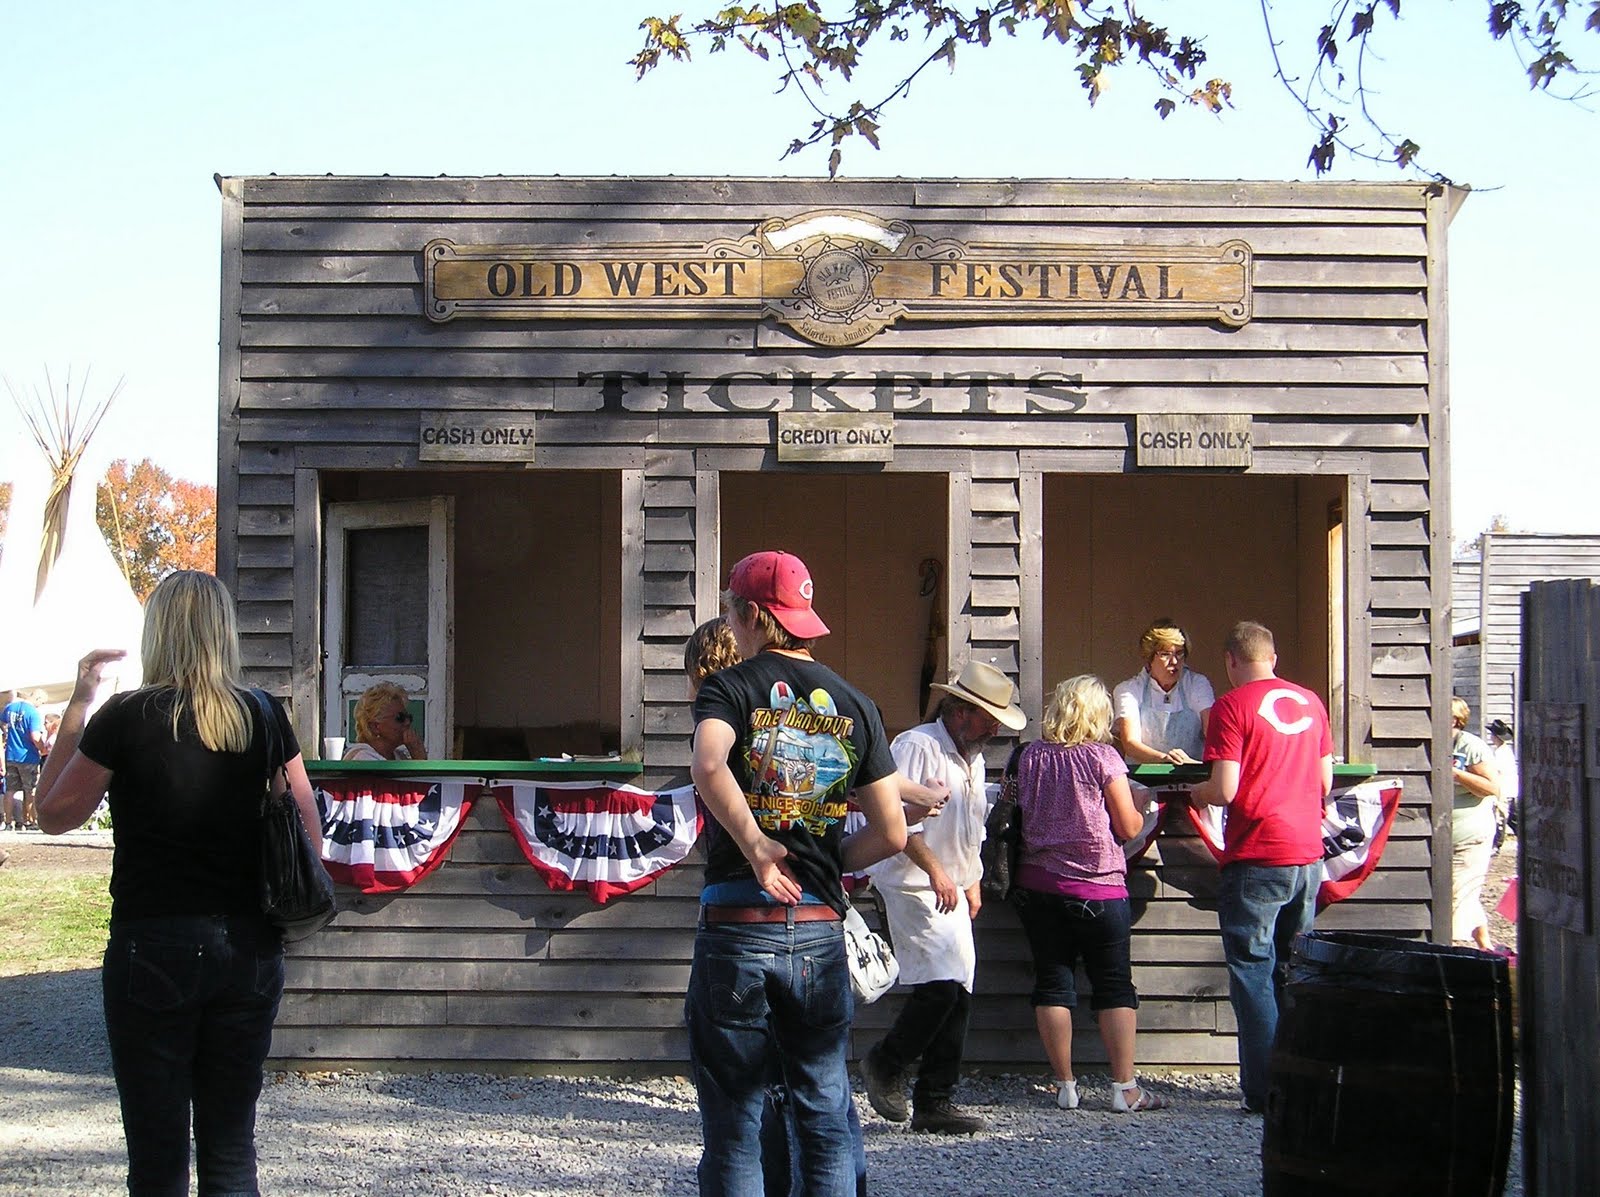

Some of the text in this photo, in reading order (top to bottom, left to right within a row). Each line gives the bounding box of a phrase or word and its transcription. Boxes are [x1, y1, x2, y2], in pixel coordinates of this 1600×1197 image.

[486, 262, 1184, 300] OLD WEST FESTIVAL
[827, 284, 857, 300] FESTIVAL
[800, 322, 875, 343] Saturdays Sundays
[577, 371, 1089, 414] TICKETS
[422, 427, 533, 445] CASH ONLY
[781, 429, 892, 445] CREDIT ONLY
[1140, 431, 1250, 449] CASH ONLY
[1257, 688, 1313, 735] C
[761, 796, 793, 810] NICE
